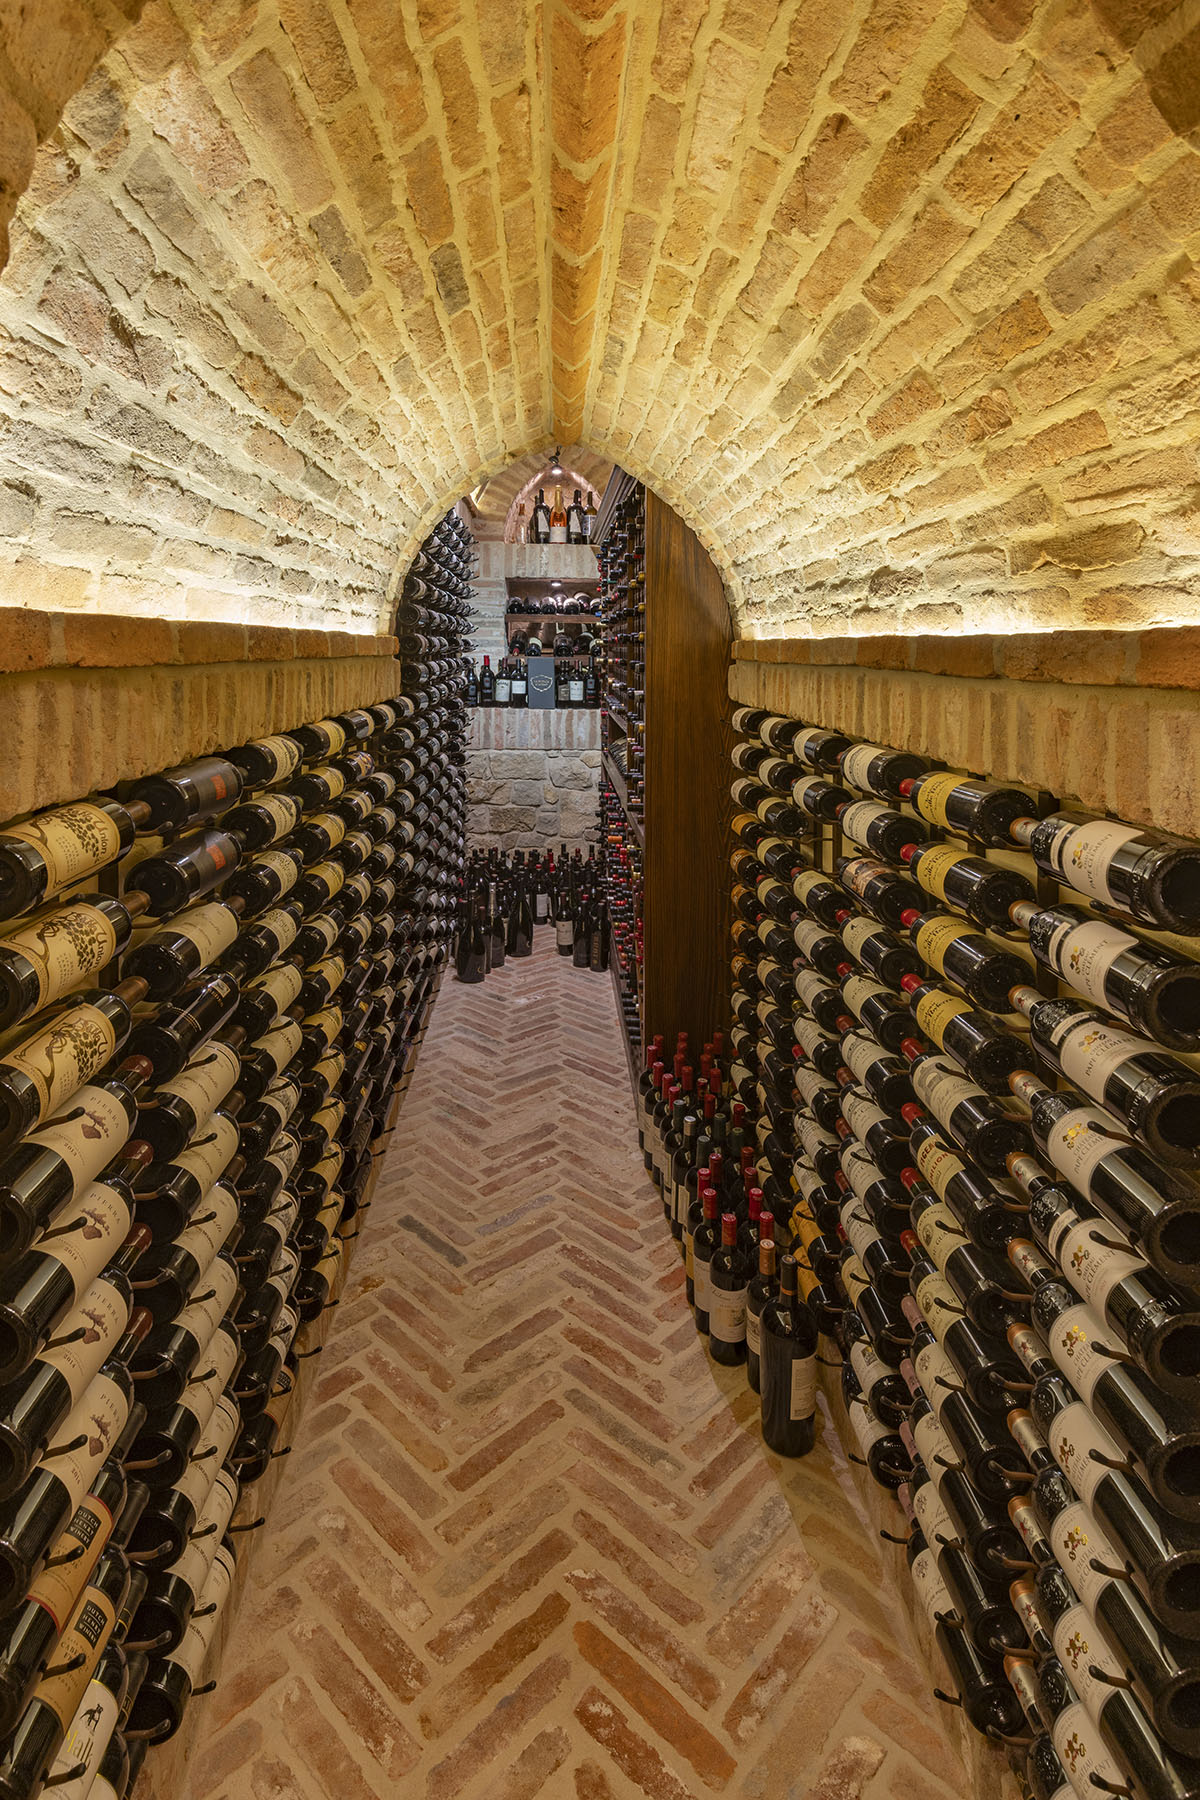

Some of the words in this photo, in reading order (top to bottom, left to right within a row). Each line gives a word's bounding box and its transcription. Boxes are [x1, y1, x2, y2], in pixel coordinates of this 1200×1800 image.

[92, 819, 109, 855] Union
[89, 1192, 121, 1224] PIERRA
[89, 1290, 120, 1325] PIERRA
[73, 1518, 94, 1536] HENRY
[77, 1509, 99, 1528] DUTCH
[69, 1526, 90, 1544] WINERY
[82, 1614, 101, 1635] HENRY
[87, 1605, 105, 1626] DUTCH
[78, 1622, 97, 1644] WINERY
